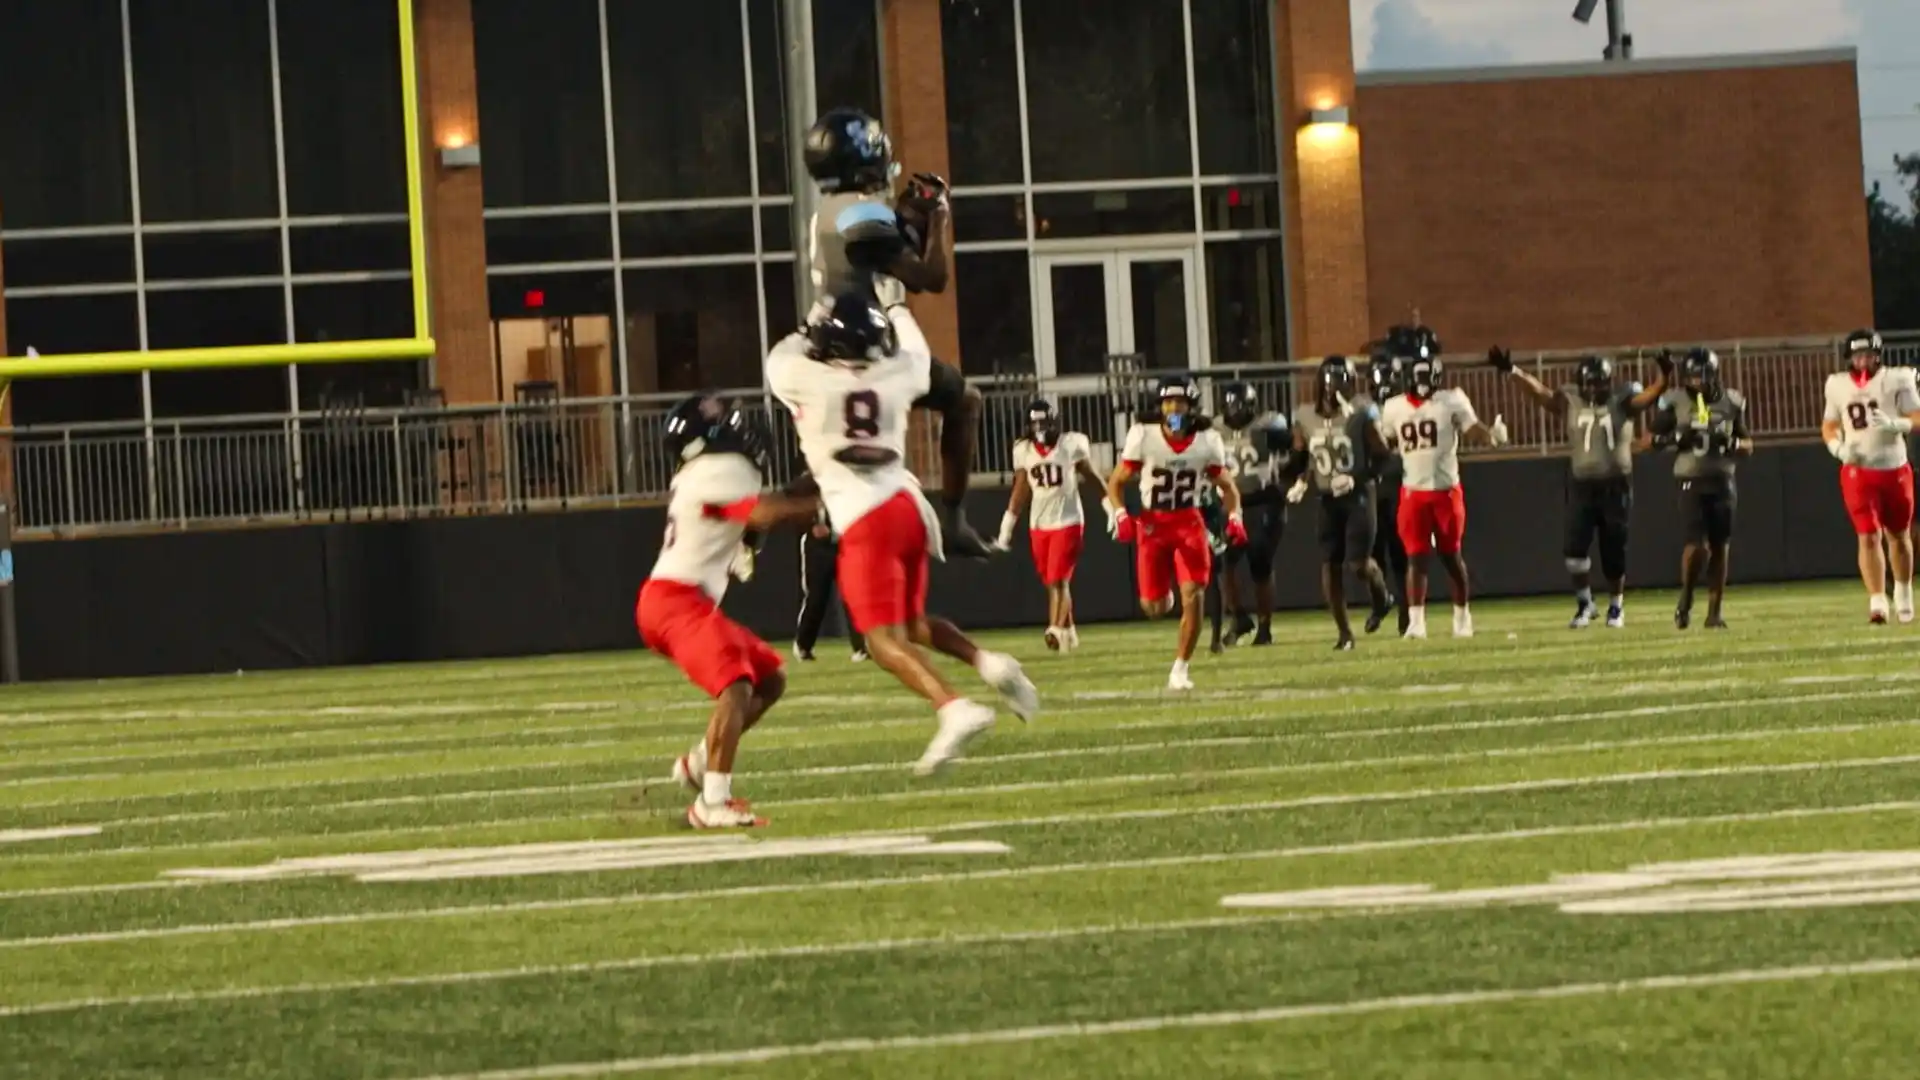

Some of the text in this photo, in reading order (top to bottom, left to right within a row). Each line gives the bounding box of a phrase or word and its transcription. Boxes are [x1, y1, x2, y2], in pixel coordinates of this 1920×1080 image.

[842, 389, 879, 440] 8
[1577, 413, 1615, 453] 71
[1309, 435, 1354, 476] 53
[1400, 420, 1438, 453] 99
[1151, 468, 1197, 510] 22
